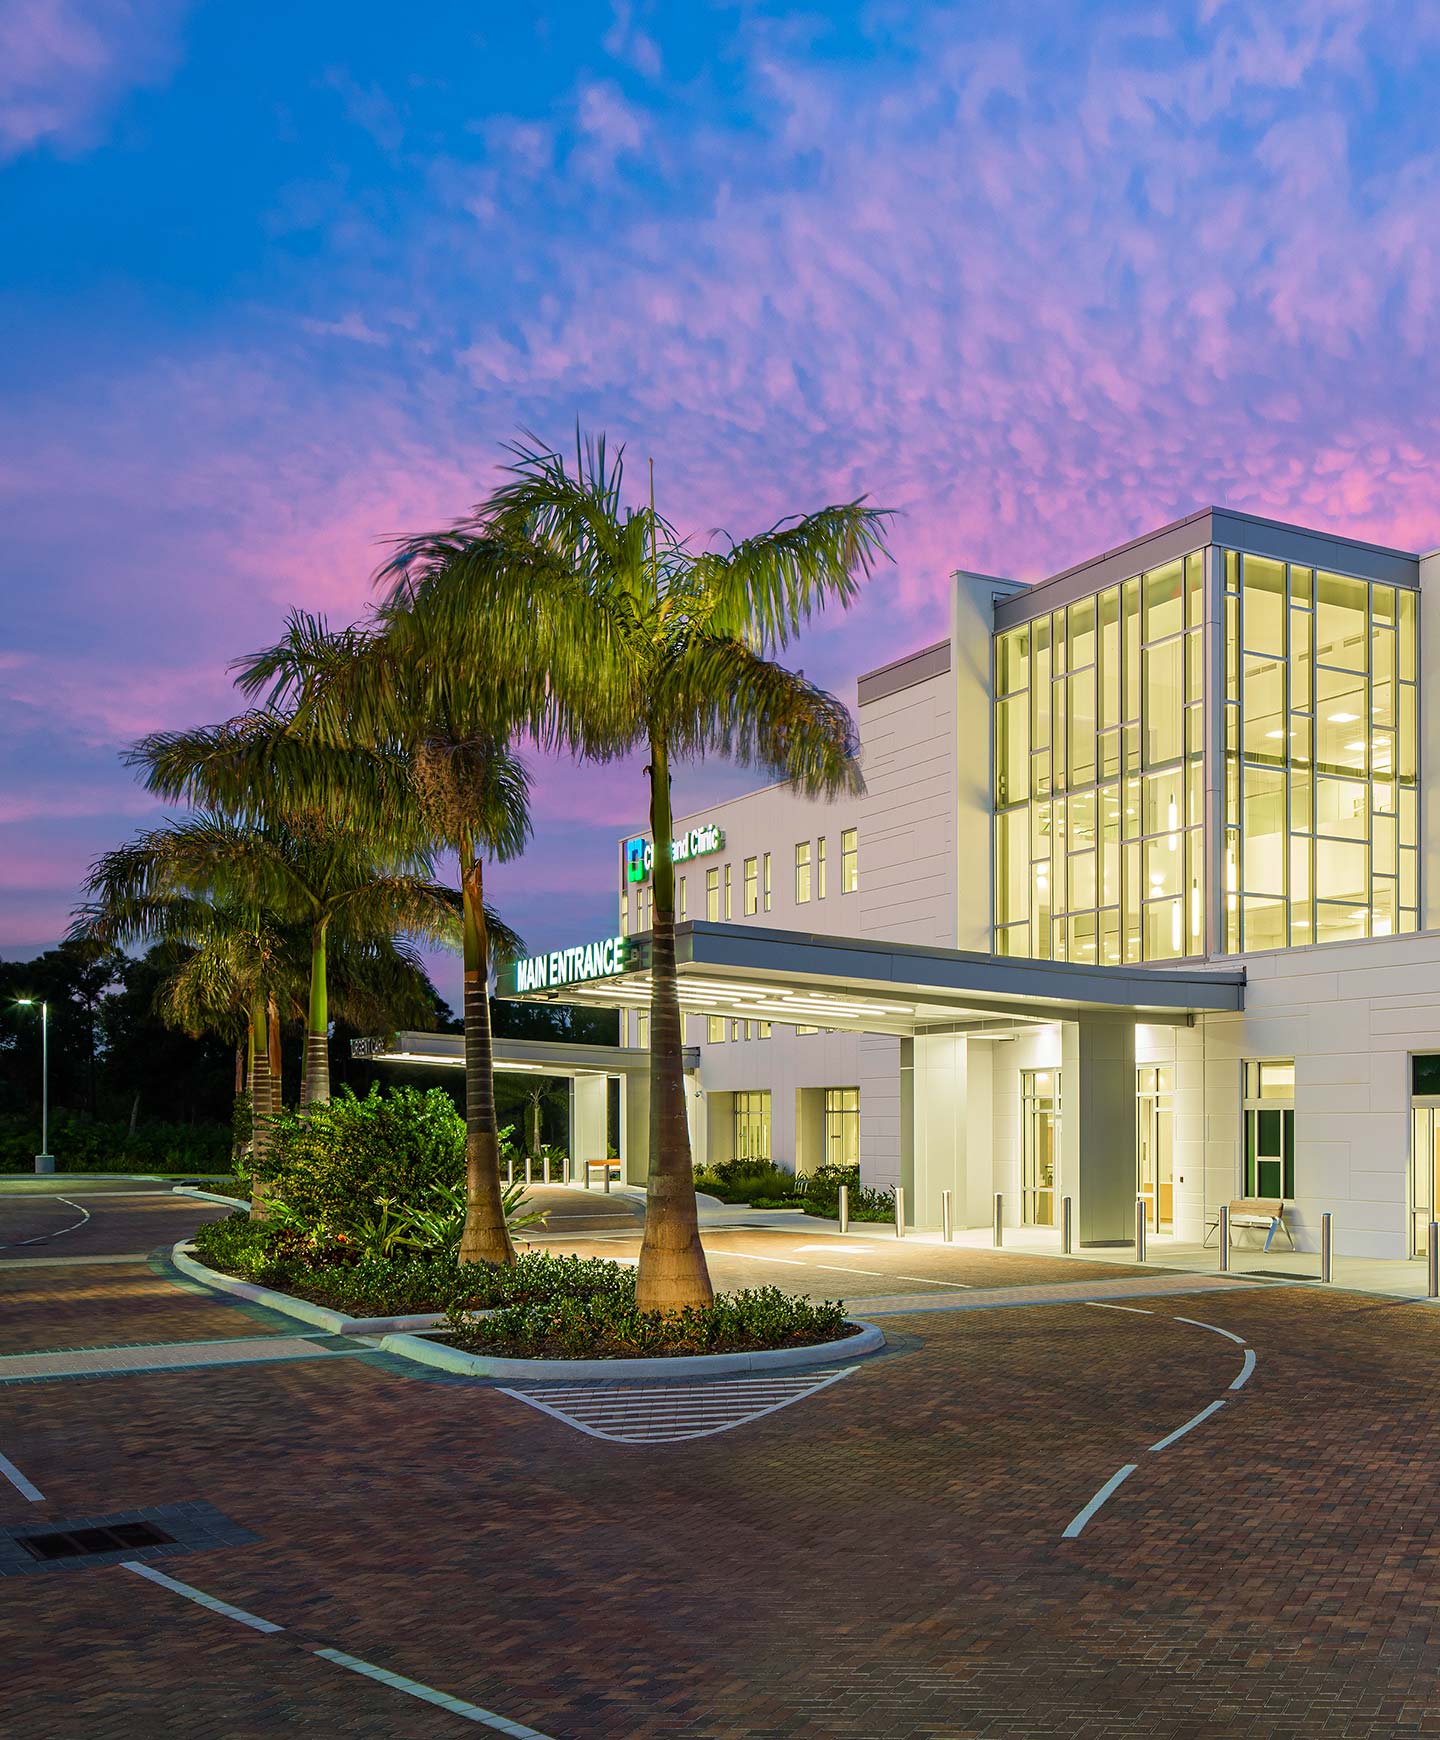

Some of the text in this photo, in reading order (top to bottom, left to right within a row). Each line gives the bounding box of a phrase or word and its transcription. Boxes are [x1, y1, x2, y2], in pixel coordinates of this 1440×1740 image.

[644, 824, 719, 870] Cland Clinic
[517, 936, 623, 992] MAIN ENTRANCE
